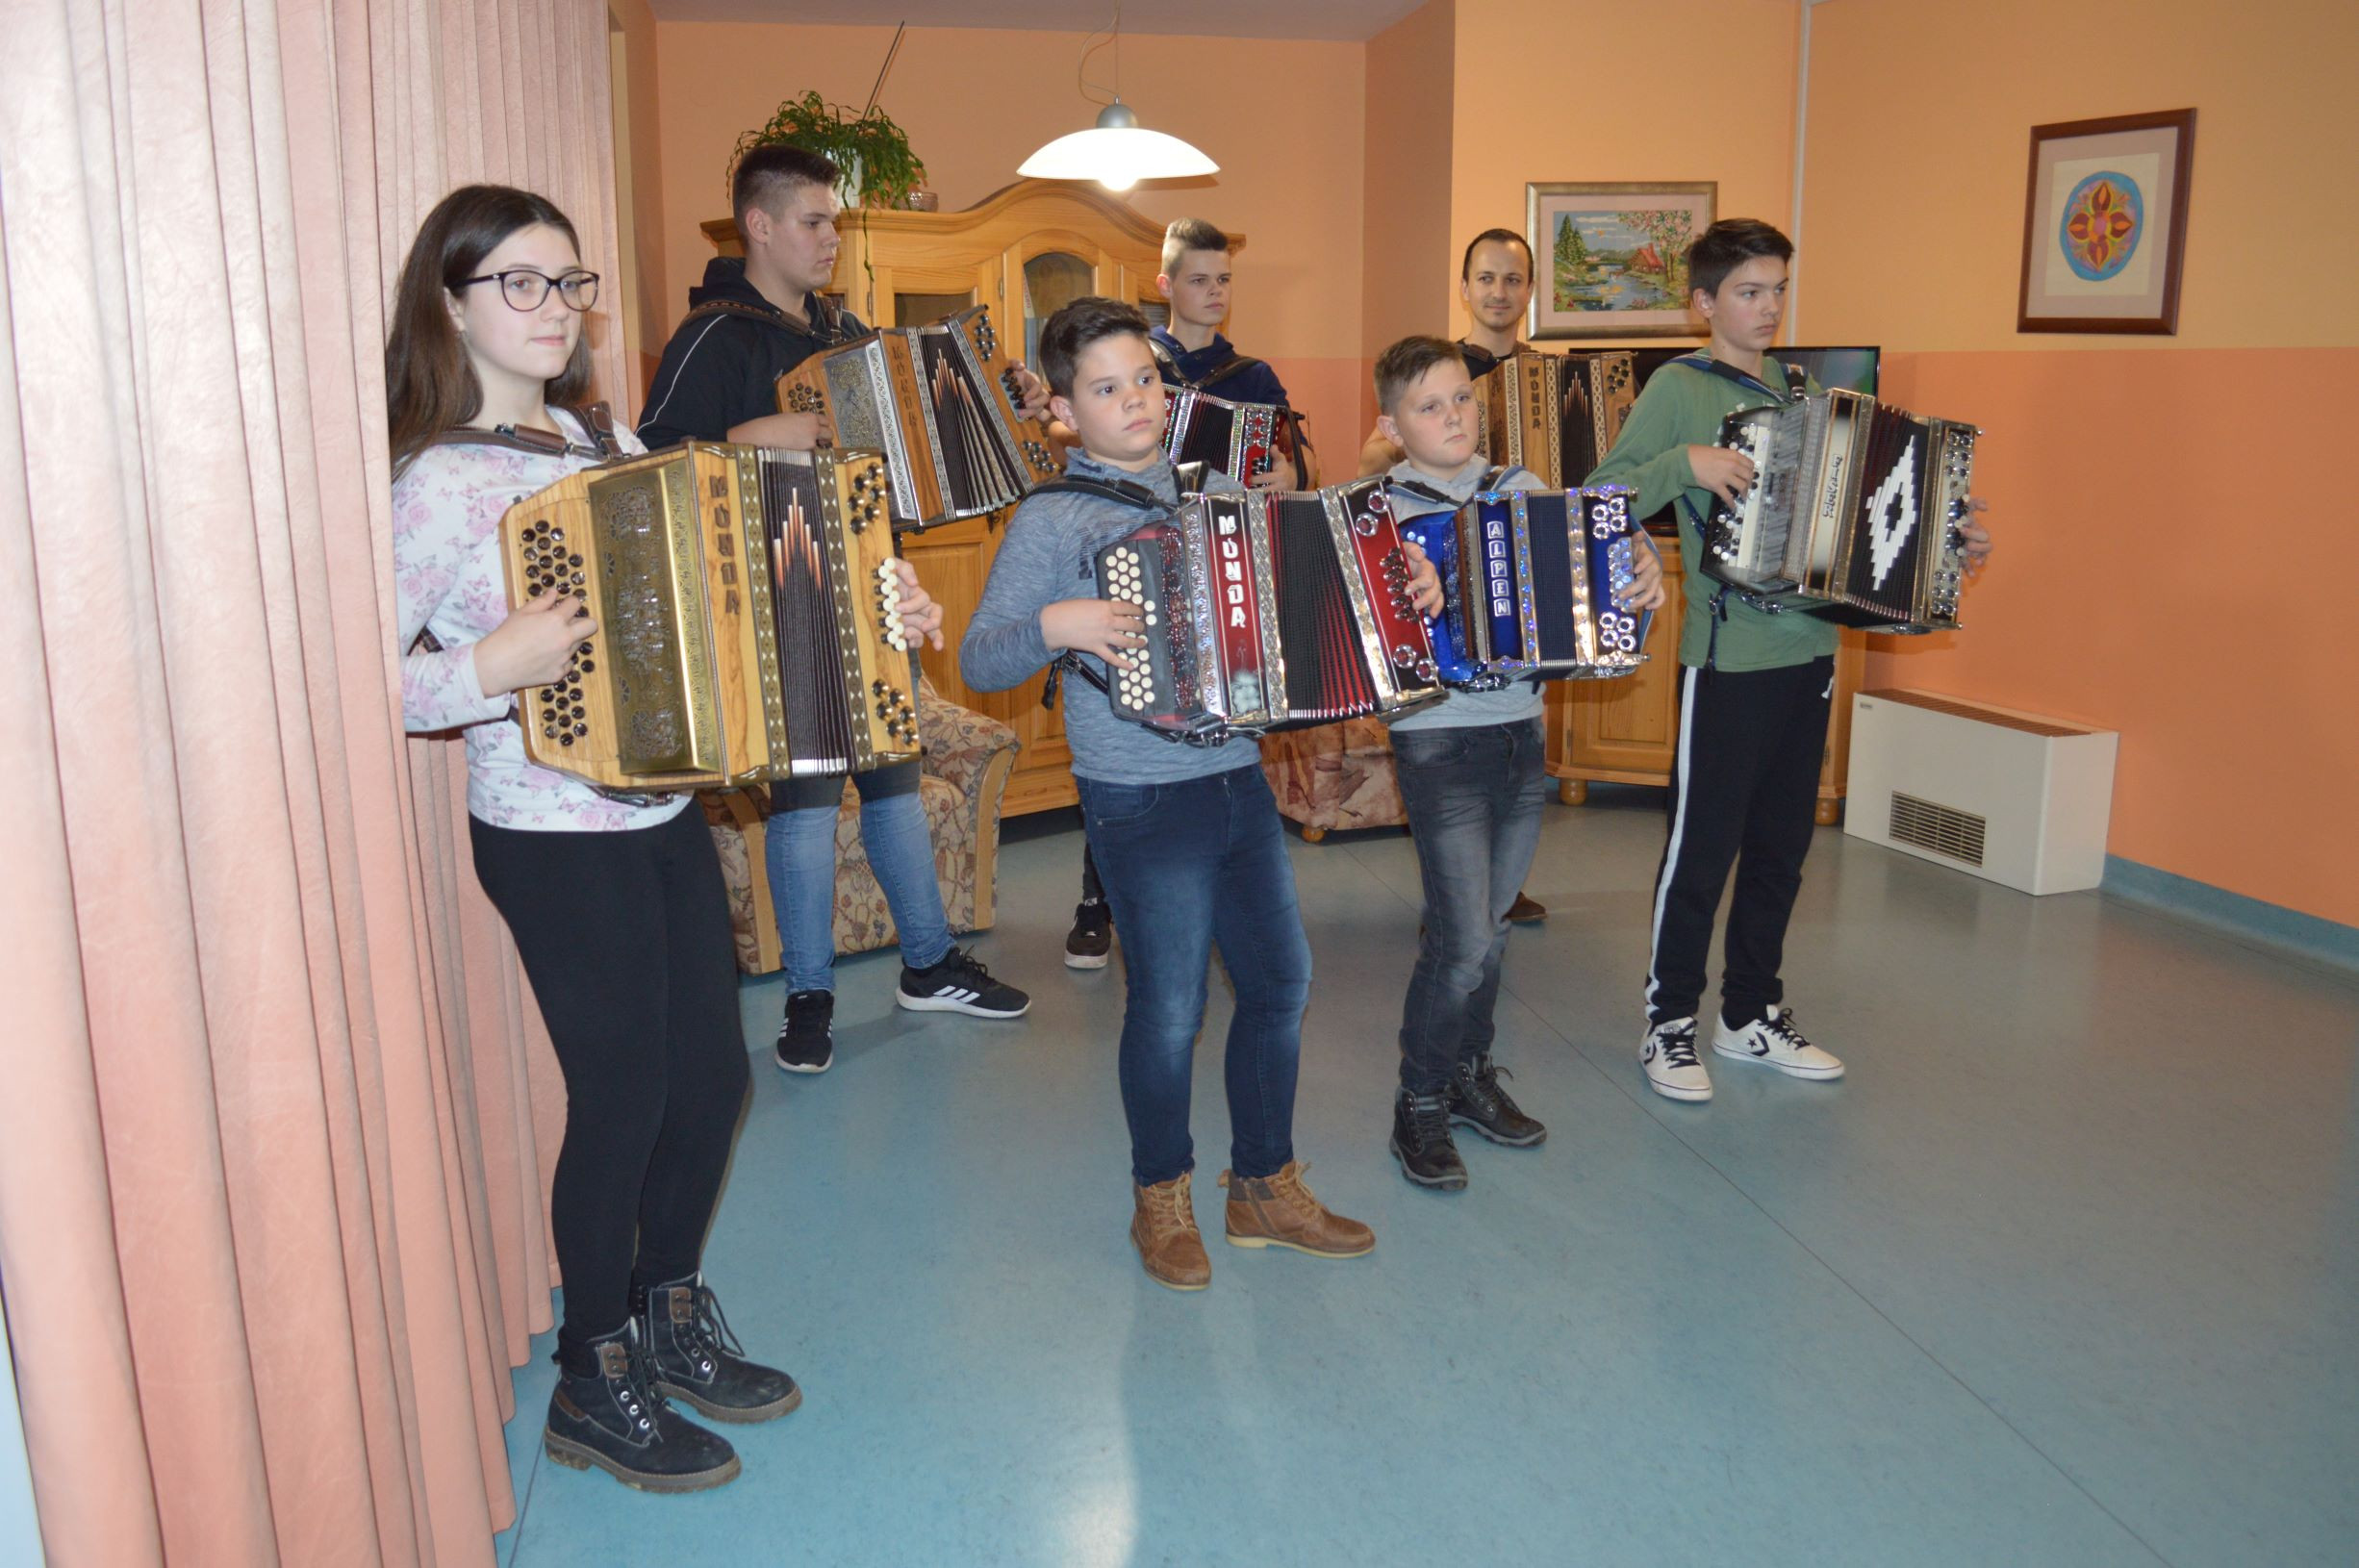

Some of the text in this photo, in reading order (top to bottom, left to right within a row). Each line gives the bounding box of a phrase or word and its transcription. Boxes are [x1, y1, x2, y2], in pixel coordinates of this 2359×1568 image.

[708, 474, 740, 616] MUNDA
[1218, 515, 1246, 628] MUNDA
[1488, 521, 1510, 617] ALPEN
